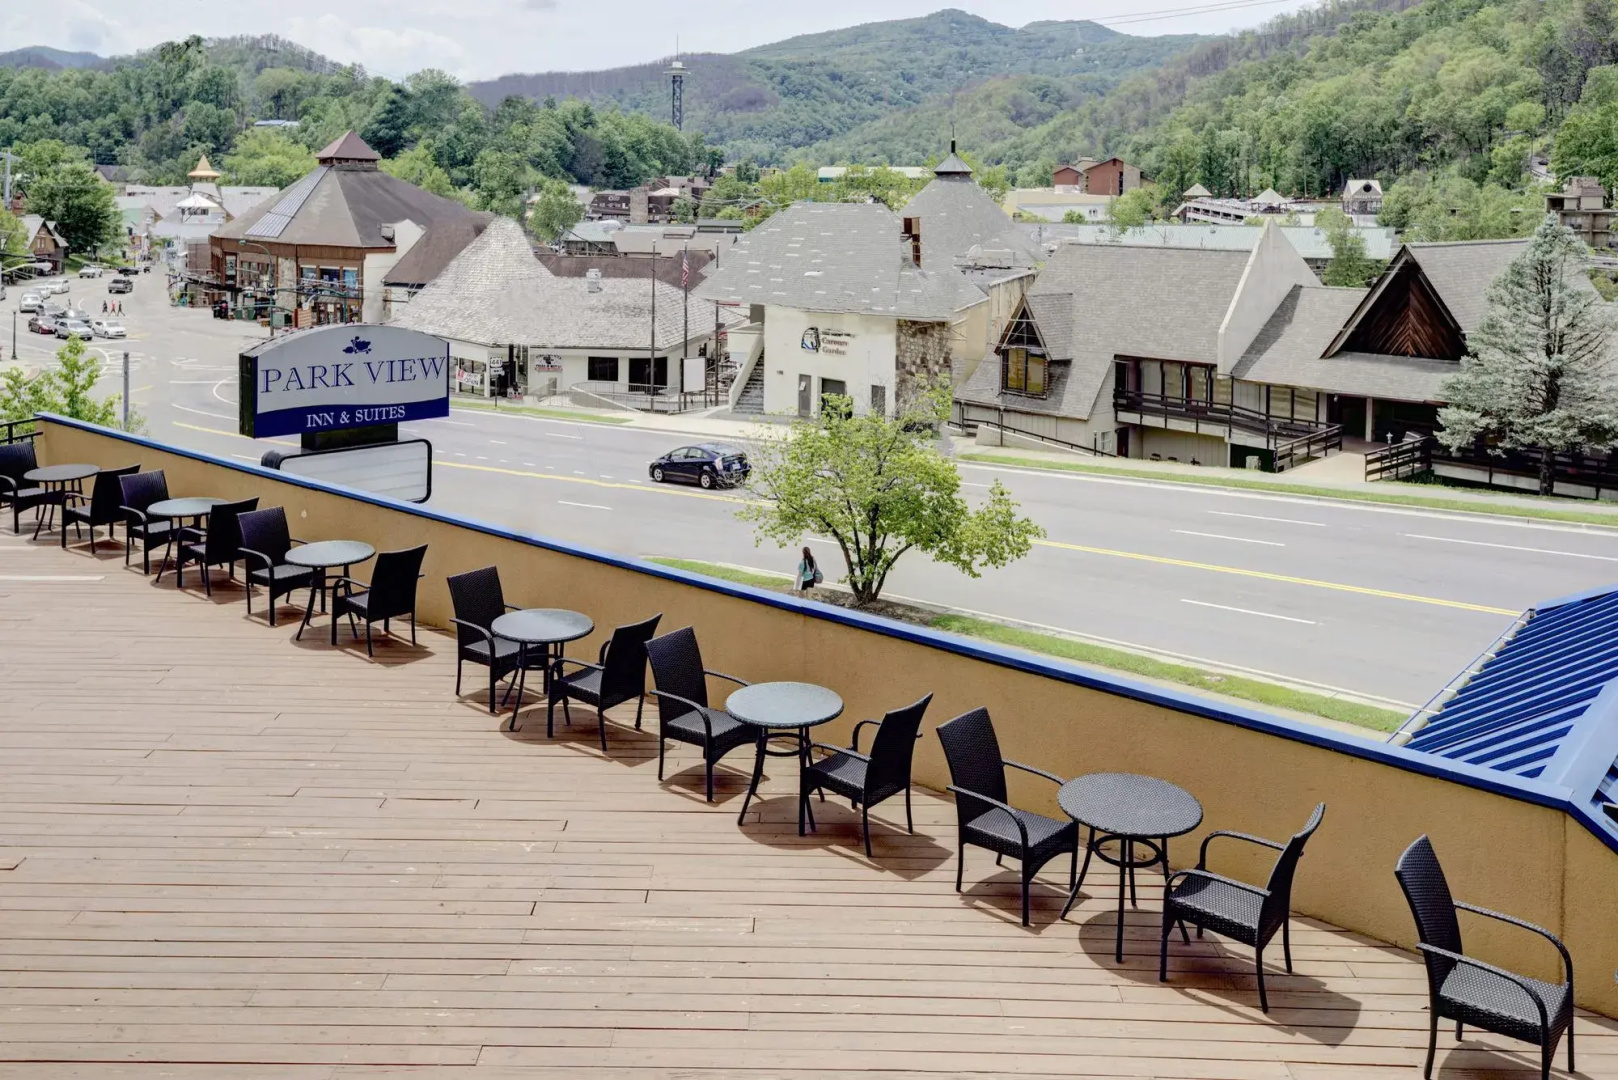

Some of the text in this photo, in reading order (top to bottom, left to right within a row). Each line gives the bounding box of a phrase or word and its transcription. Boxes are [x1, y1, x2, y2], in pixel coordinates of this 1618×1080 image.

[260, 356, 446, 393] PARK VIEW
[306, 405, 406, 428] INN & SUITES
